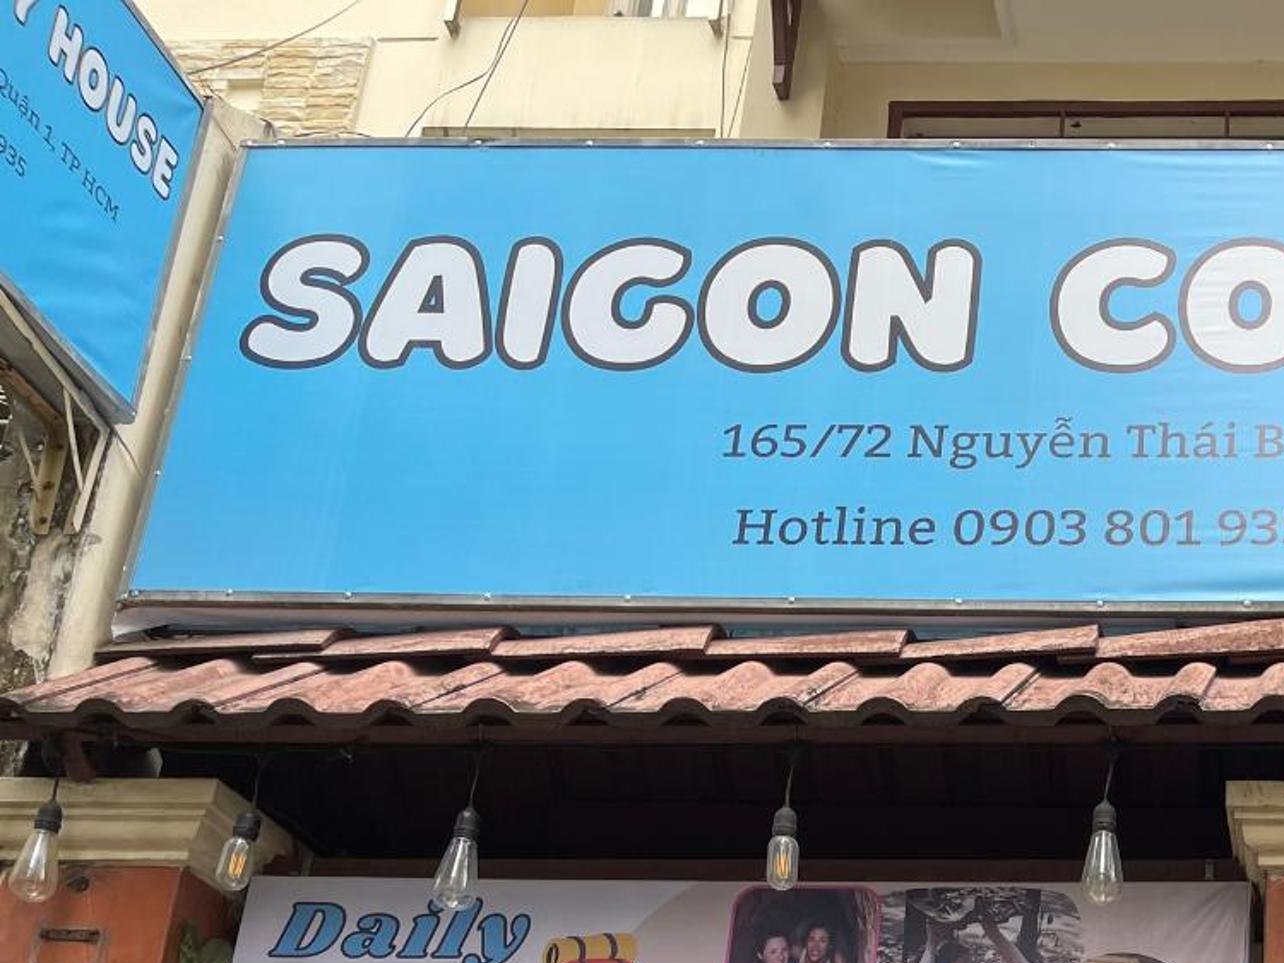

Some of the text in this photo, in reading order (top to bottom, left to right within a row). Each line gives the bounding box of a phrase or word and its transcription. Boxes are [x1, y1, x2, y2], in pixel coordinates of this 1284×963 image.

[48, 4, 180, 201] HOUSE
[60, 141, 81, 174] TP
[82, 169, 120, 224] HCM
[239, 234, 982, 373] SAIGON
[722, 423, 892, 459] 165/72
[908, 416, 1111, 468] Nguyễn
[1127, 420, 1239, 459] Thái
[733, 507, 936, 546] Hotline
[953, 508, 1087, 546] 0903
[1104, 509, 1200, 546] 801
